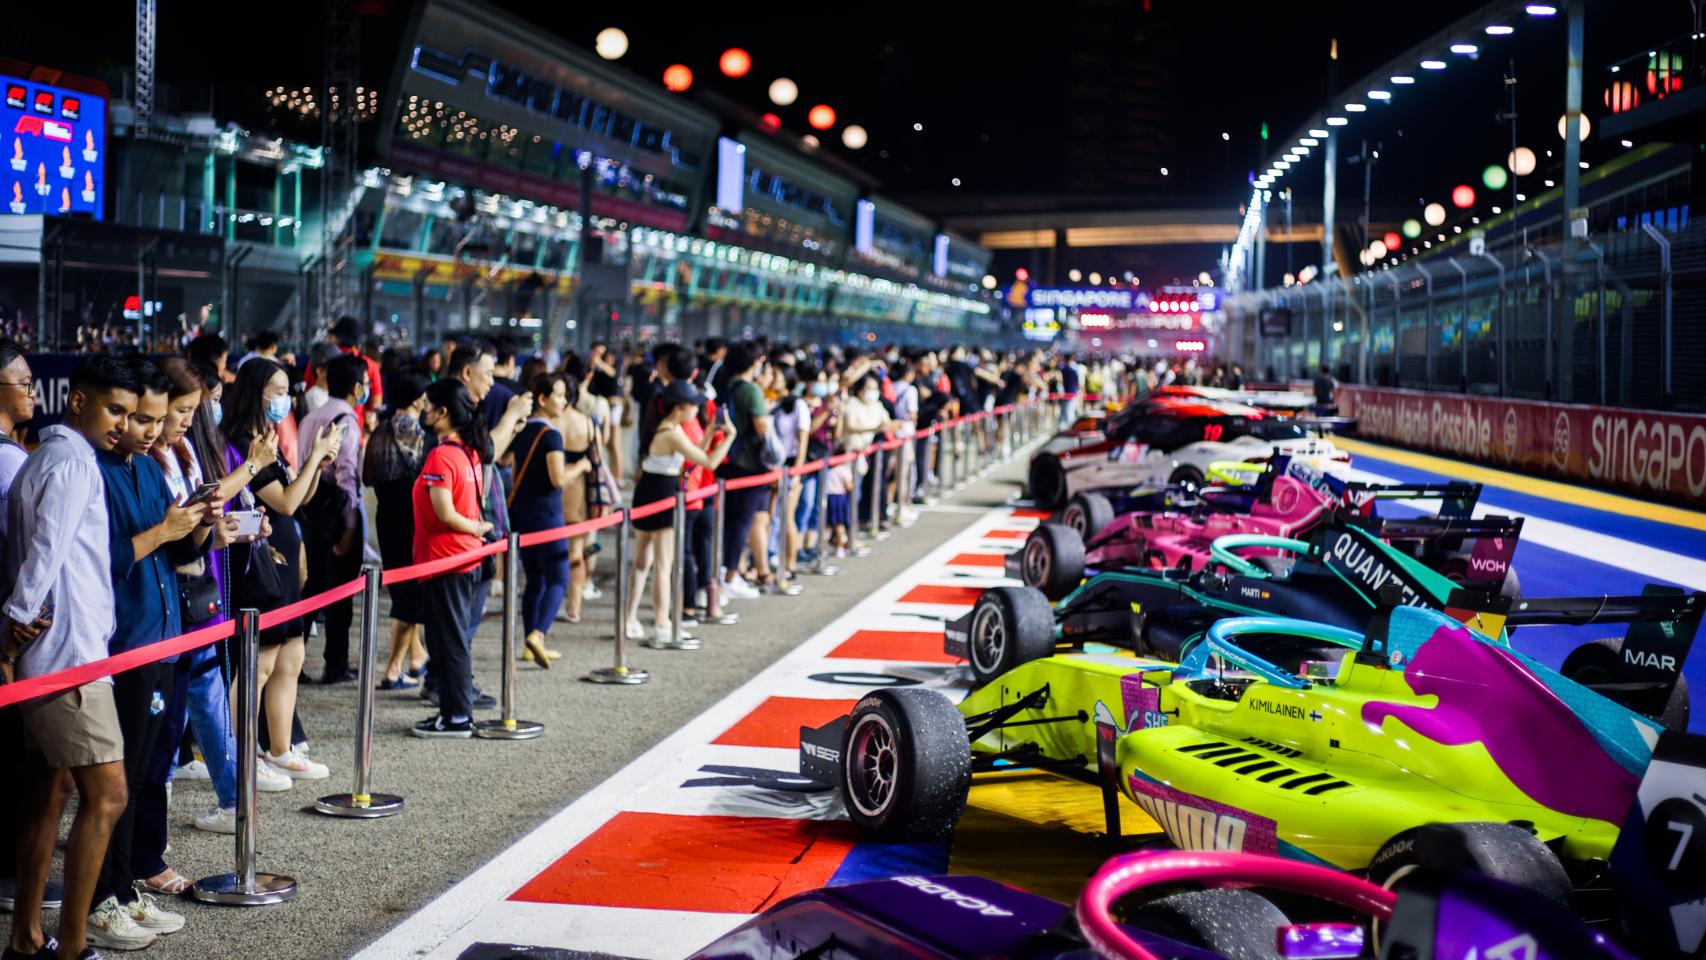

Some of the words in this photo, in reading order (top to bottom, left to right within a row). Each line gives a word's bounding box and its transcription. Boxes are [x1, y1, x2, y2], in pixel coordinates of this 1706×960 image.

[1031, 289, 1132, 308] SINGAPORE
[1354, 393, 1394, 438] Passion
[1395, 398, 1430, 447] Made
[1432, 400, 1492, 459] Possible
[1471, 557, 1506, 573] WOH
[1241, 586, 1260, 599] MARTI
[1625, 648, 1676, 672] MAR
[1249, 698, 1305, 720] KIMILAINEN
[1666, 819, 1693, 871] 7
